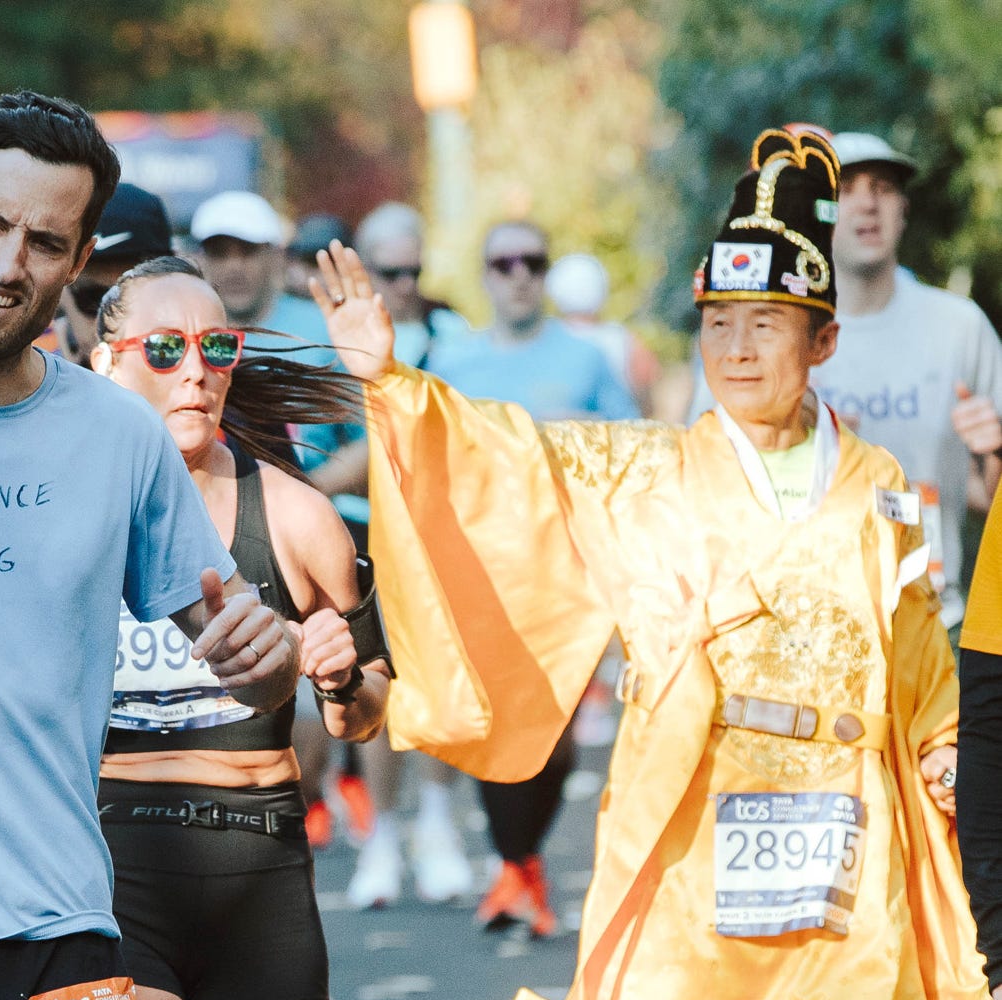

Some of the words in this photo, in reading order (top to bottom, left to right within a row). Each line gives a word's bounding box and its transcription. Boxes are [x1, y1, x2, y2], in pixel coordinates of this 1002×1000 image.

[734, 797, 770, 821] tcs
[726, 828, 859, 872] 28945
[92, 987, 113, 997] TATA
